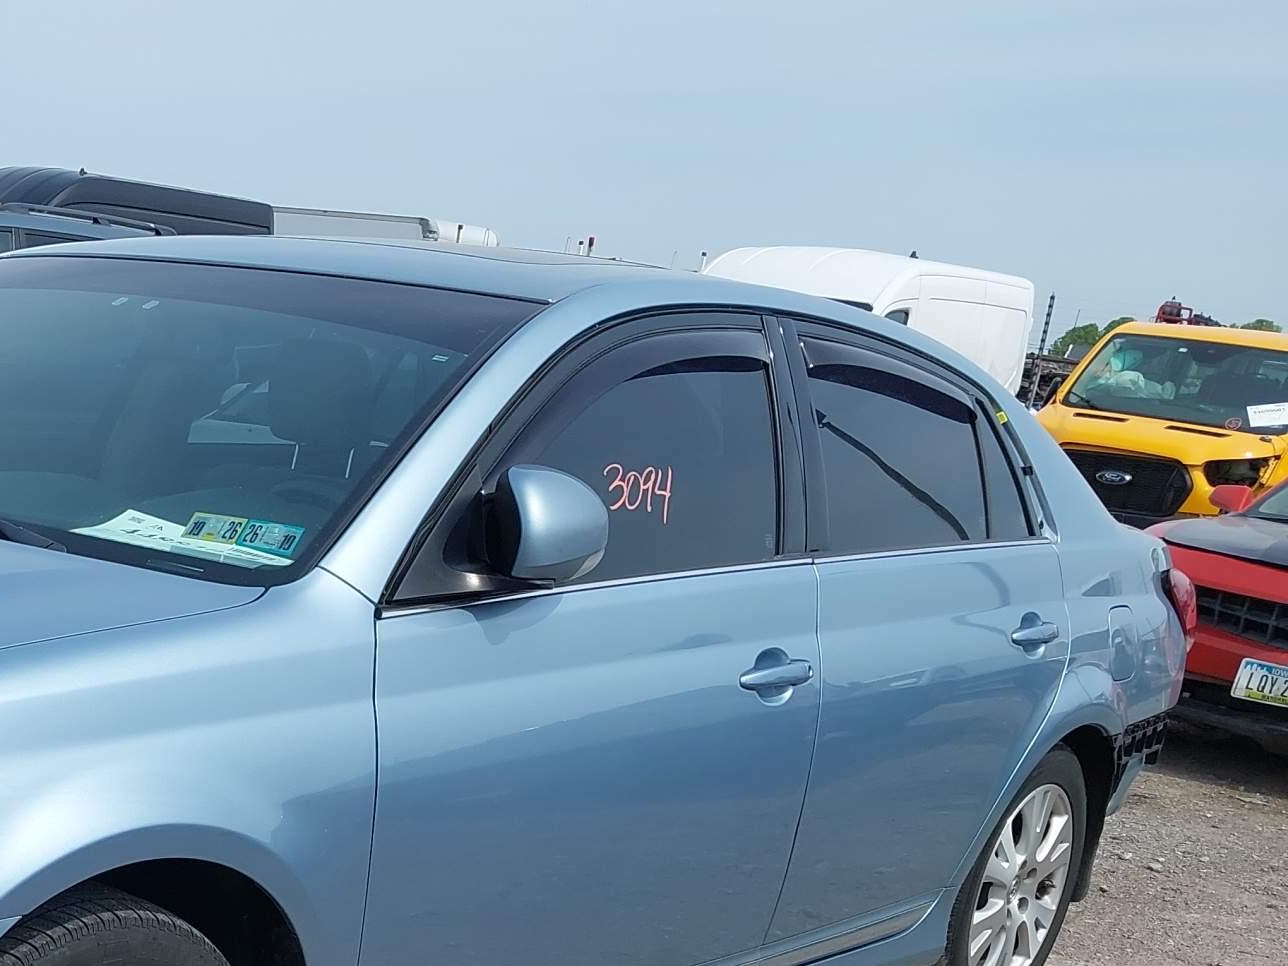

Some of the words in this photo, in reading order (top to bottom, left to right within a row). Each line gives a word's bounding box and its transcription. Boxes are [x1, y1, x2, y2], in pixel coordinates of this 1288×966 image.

[603, 463, 672, 525] 3094
[221, 521, 243, 540] 26
[243, 523, 263, 543] 26
[1245, 671, 1279, 695] LQY
